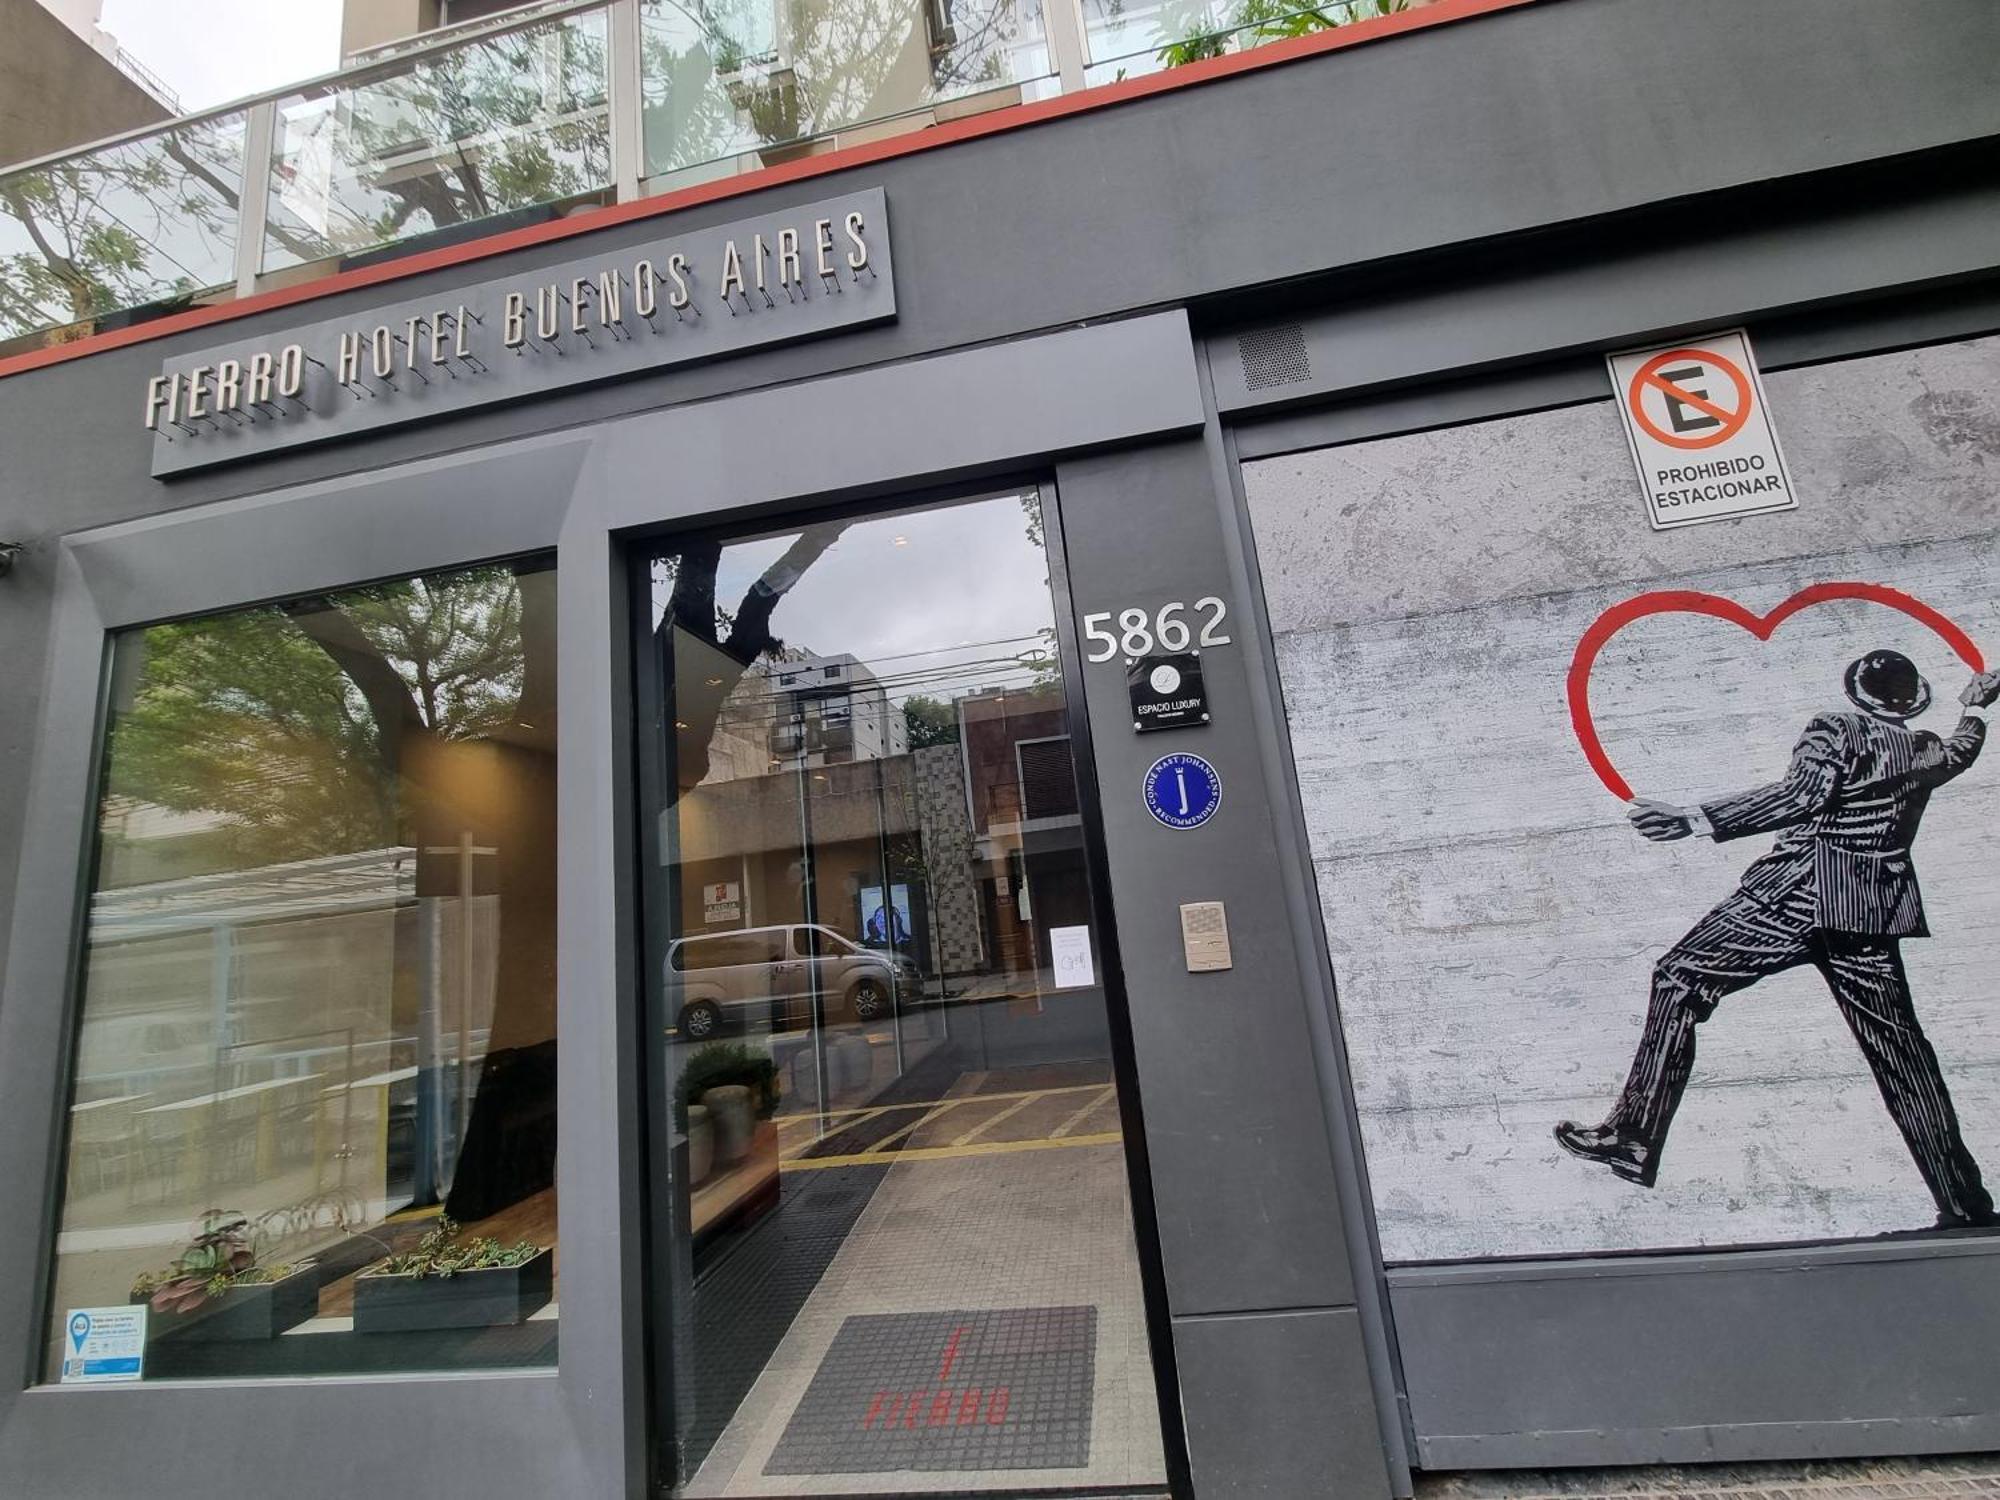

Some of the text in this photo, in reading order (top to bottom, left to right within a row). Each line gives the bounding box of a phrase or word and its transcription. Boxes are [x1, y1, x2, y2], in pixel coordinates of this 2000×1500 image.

[145, 211, 870, 430] FIERRO HOTEL BUENOS AIRES
[1657, 366, 1720, 432] E
[1657, 455, 1765, 486] PROHIBIDO
[1655, 475, 1782, 508] ESTACIONAR
[1083, 596, 1232, 662] 5862
[1137, 702, 1171, 715] ESPACIO
[1171, 698, 1201, 711] LUXURY
[1155, 756, 1179, 773] NAST
[1180, 756, 1219, 797] JOHANSENS
[1155, 800, 1216, 826] RECOMMENDED
[864, 1387, 1009, 1430] FIERRO
